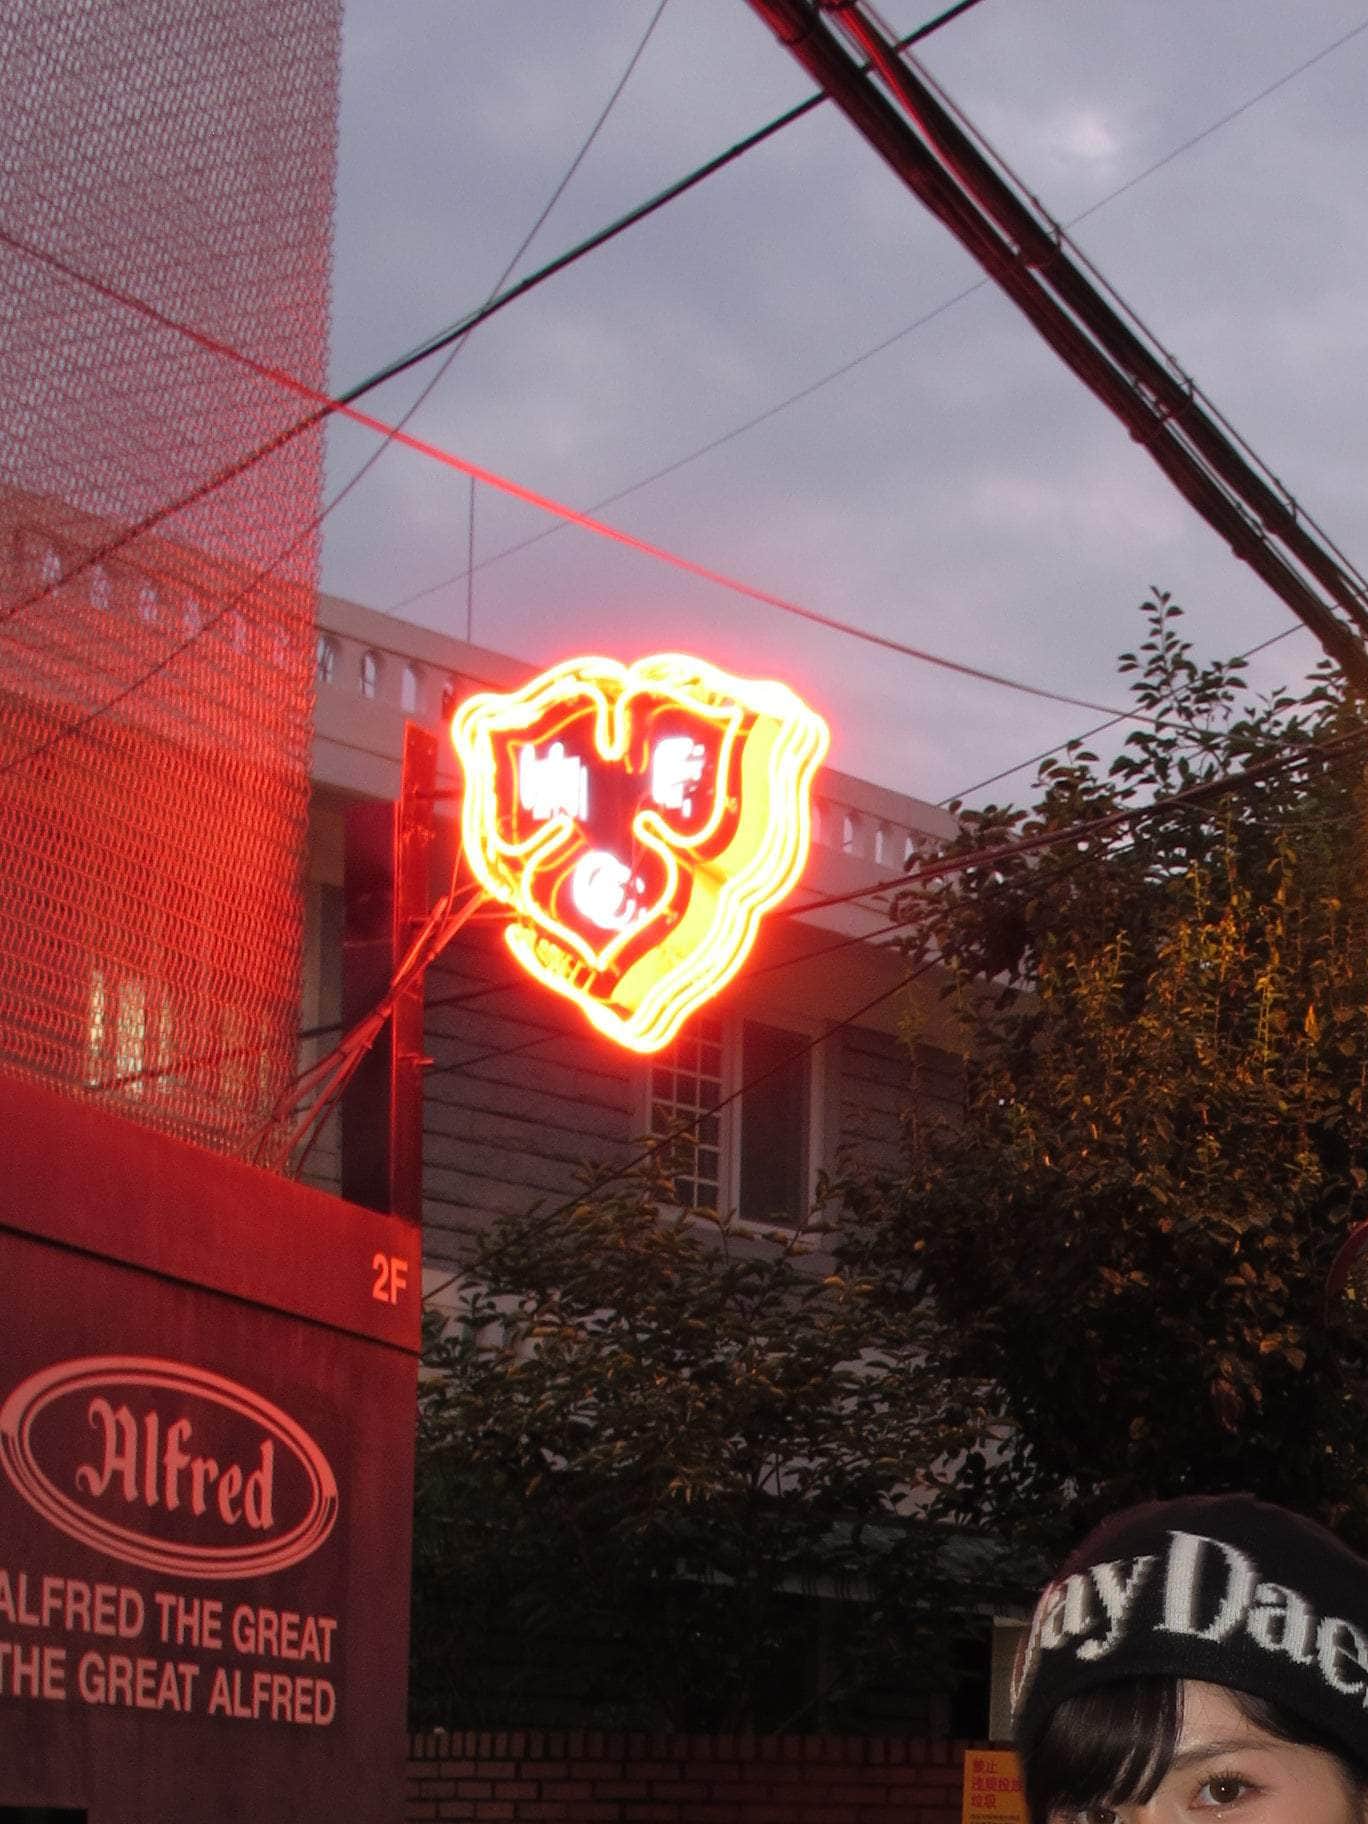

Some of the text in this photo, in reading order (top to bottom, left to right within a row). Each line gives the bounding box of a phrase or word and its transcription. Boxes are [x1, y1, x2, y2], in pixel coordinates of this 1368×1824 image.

[373, 1253, 408, 1305] 2F
[76, 1398, 274, 1529] Alfred
[0, 1568, 337, 1663] ALFRED THE GREAT
[1011, 1555, 1160, 1722] ay
[78, 1650, 199, 1712] GREAT
[208, 1667, 336, 1726] ALFRED
